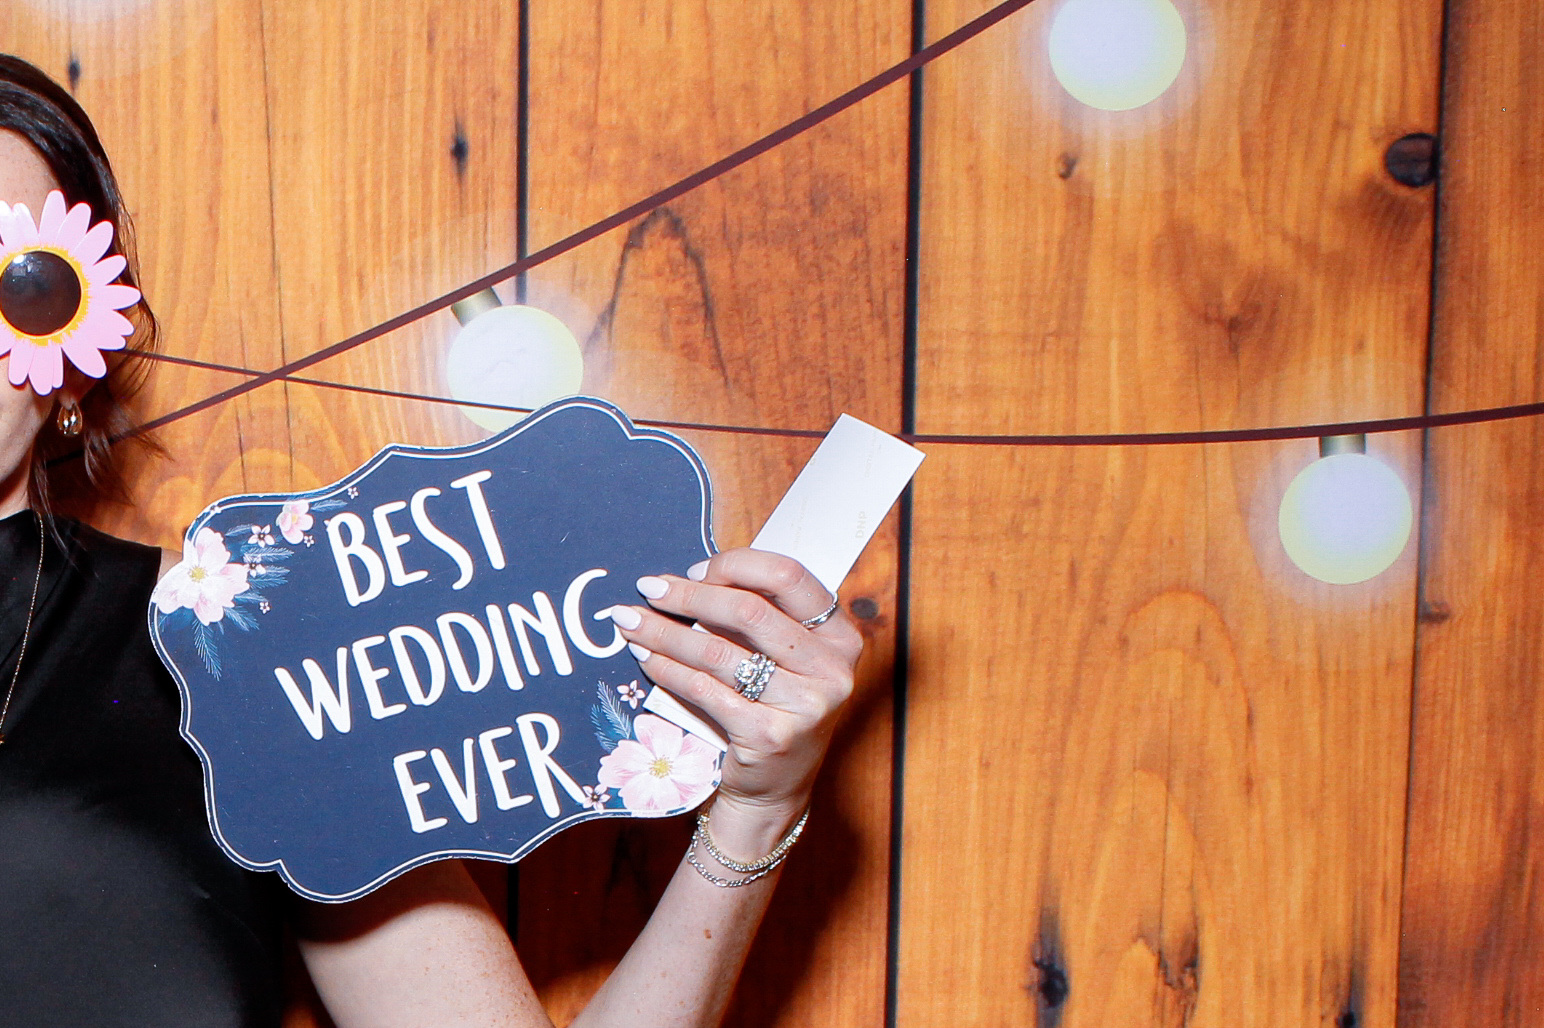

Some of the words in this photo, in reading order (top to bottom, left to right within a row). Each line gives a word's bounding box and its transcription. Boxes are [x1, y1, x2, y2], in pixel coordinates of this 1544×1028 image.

[323, 469, 507, 608] BEST
[855, 510, 868, 539] DNP
[274, 568, 628, 741] WEDDING
[392, 712, 588, 835] EVER
